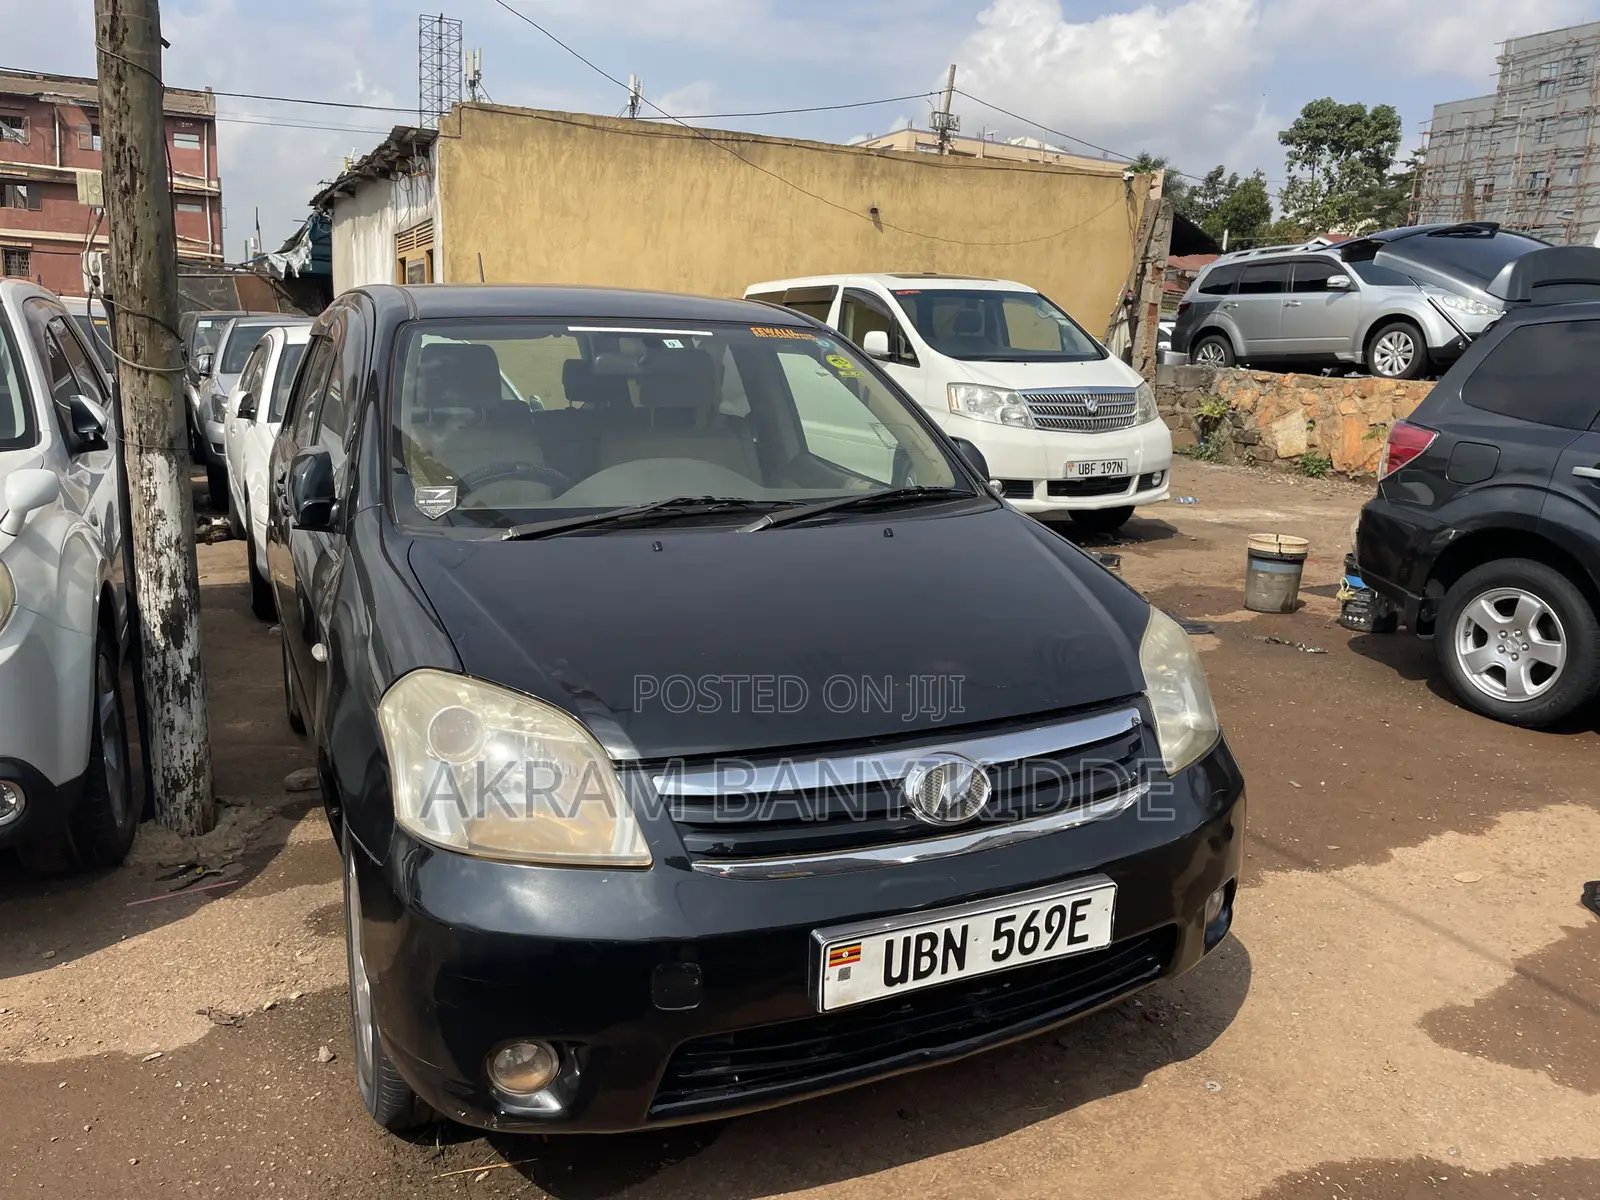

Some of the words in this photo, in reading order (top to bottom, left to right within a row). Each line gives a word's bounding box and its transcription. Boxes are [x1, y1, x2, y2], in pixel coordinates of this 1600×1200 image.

[1078, 462, 1096, 475] UBF
[1101, 461, 1123, 474] 197N
[883, 924, 969, 987] UBN
[991, 897, 1092, 963] 569E
